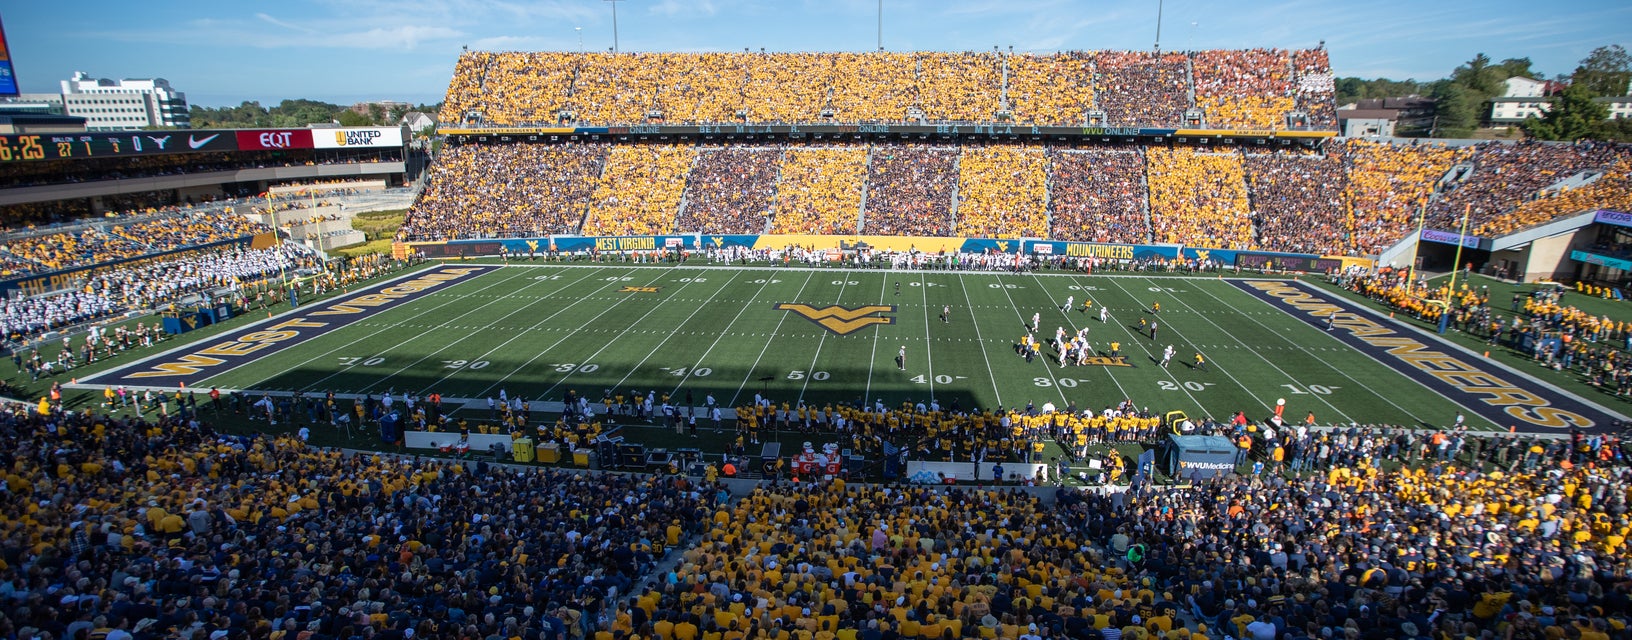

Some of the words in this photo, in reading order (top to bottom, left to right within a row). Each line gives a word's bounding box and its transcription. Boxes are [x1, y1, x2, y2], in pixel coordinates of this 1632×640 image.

[629, 126, 660, 134] ONLINE
[1083, 127, 1103, 135] WVU
[1105, 128, 1138, 136] ONLINE
[259, 132, 292, 148] EQT
[595, 238, 618, 250] WEST
[619, 237, 655, 250] VIRGINIA
[1066, 242, 1134, 259] MOUNTAINEERS
[121, 317, 329, 380] WEST
[307, 267, 488, 317] VIRGINIA
[1243, 280, 1596, 428] MOUNTAINEERS
